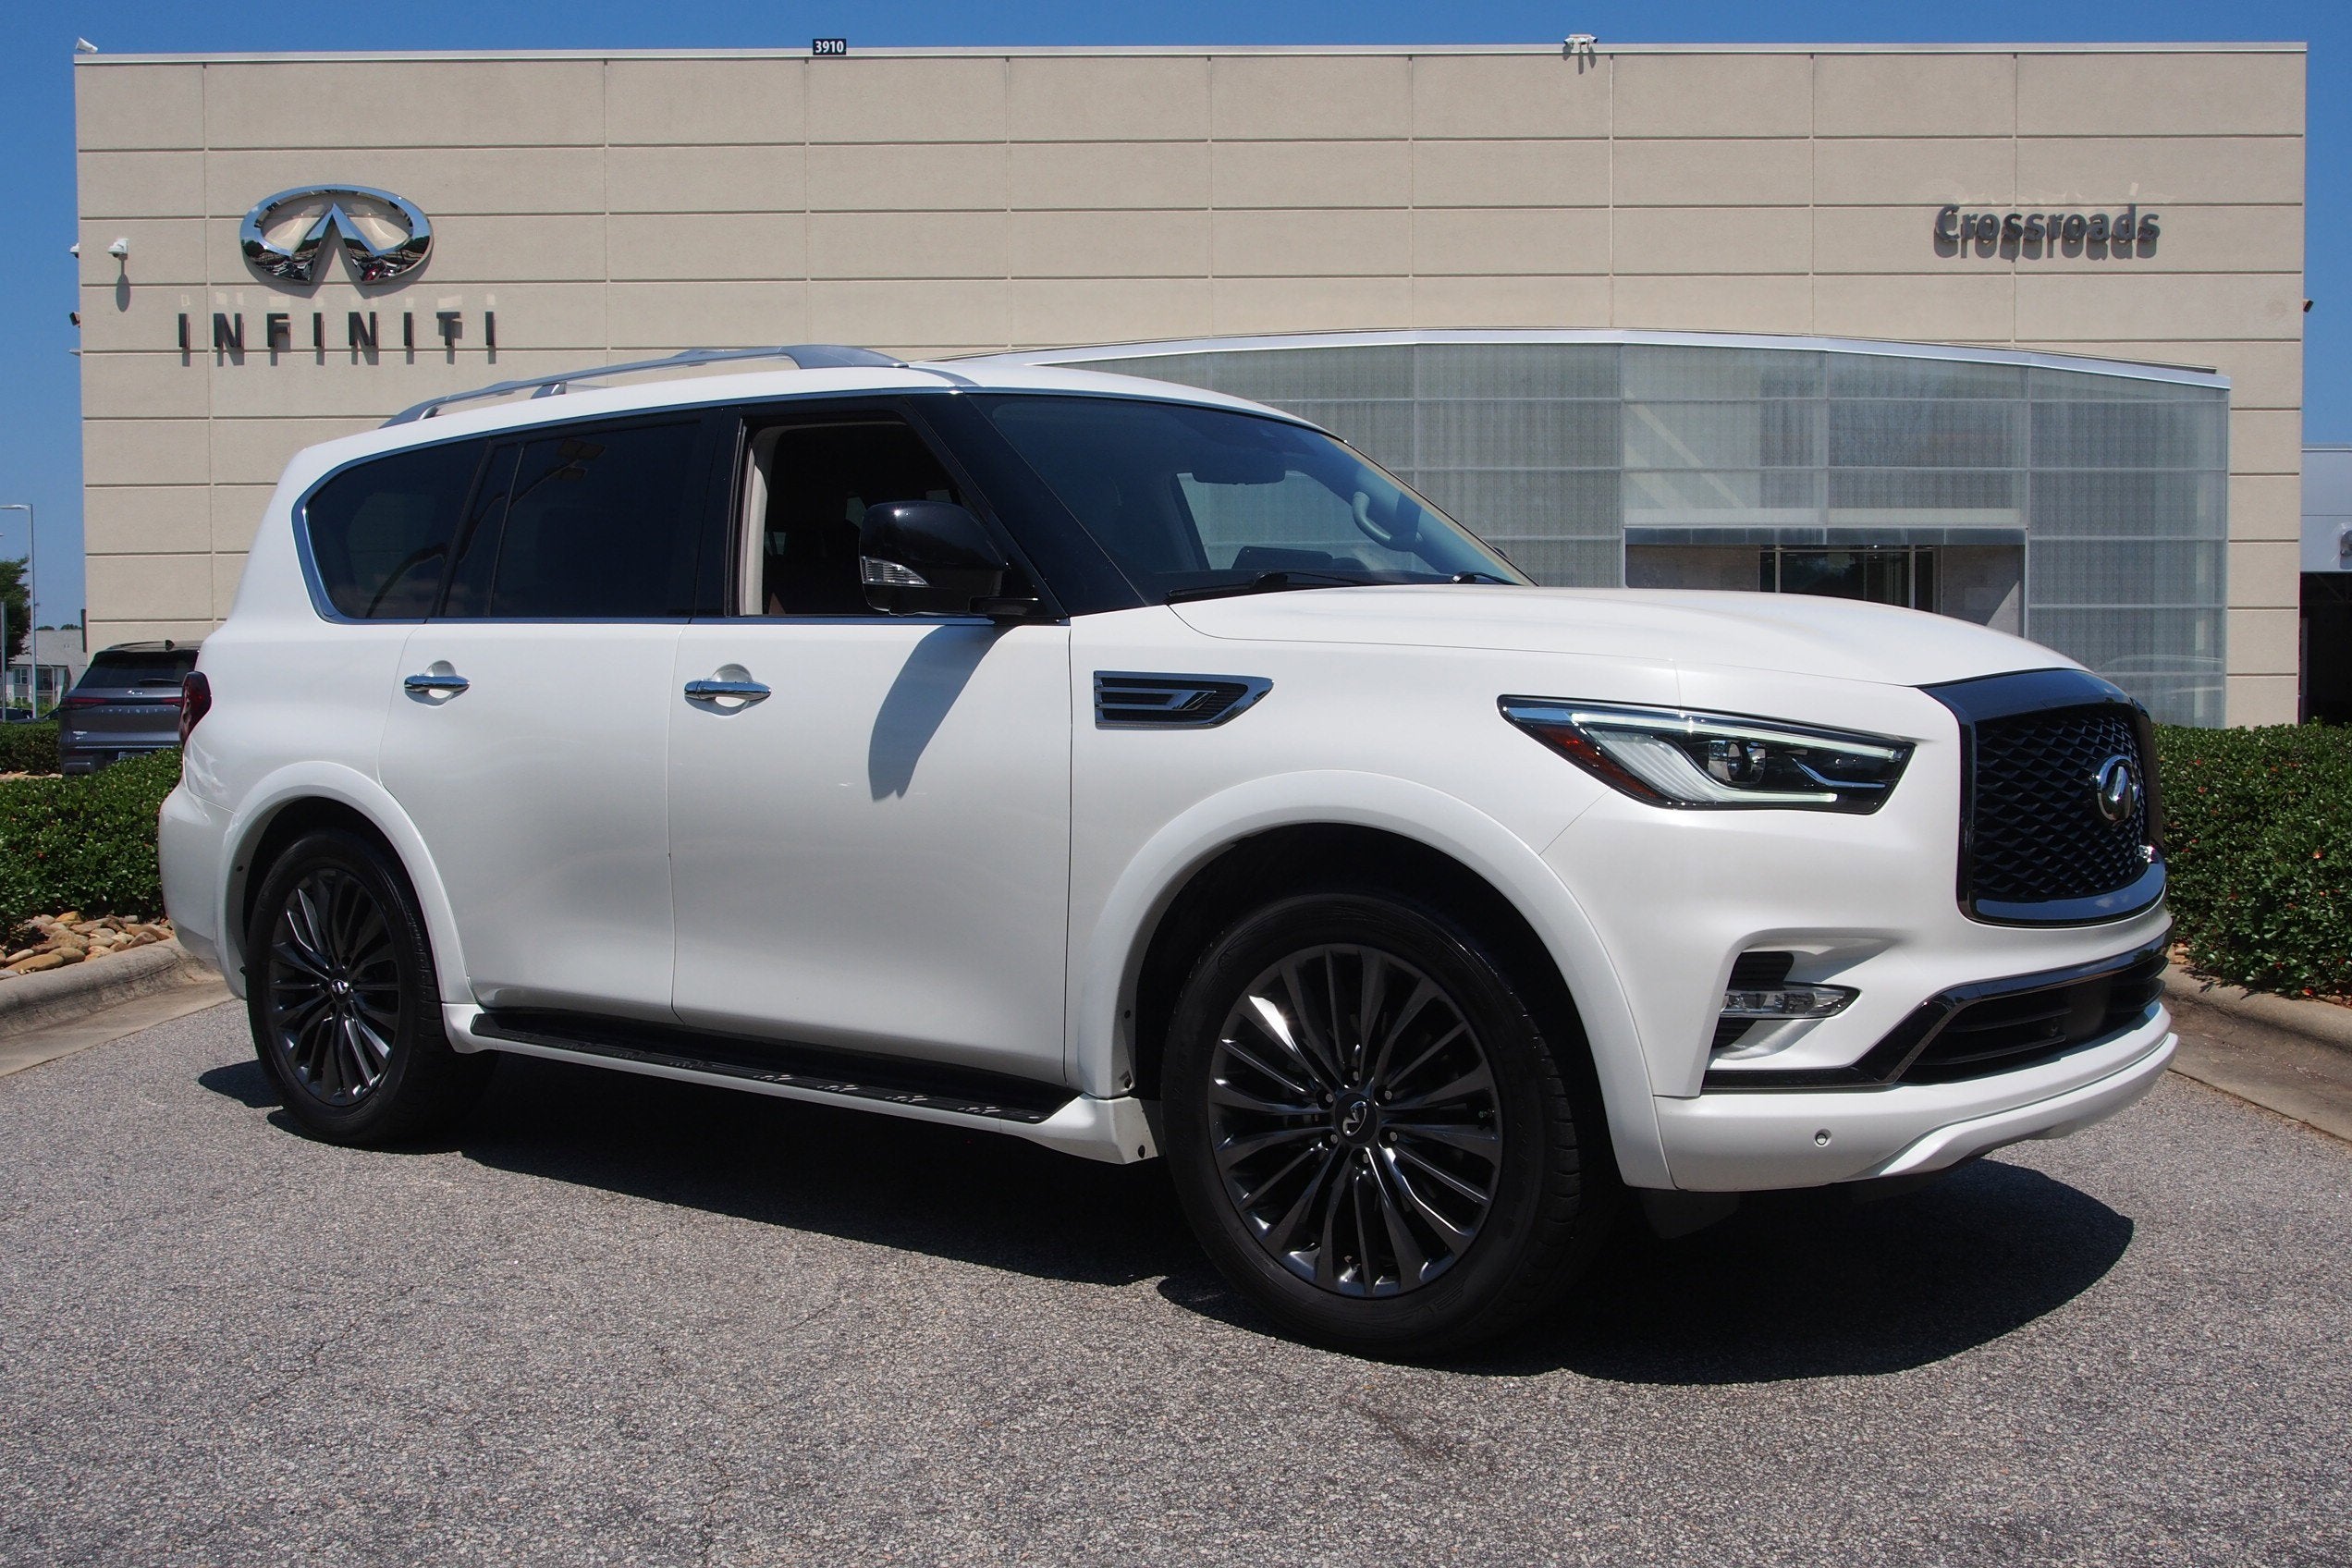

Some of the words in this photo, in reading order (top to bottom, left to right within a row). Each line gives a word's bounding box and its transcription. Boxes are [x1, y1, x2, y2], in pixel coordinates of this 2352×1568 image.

[815, 40, 844, 54] 3910
[1935, 203, 2161, 242] Crossroads
[178, 311, 496, 349] INFINITI
